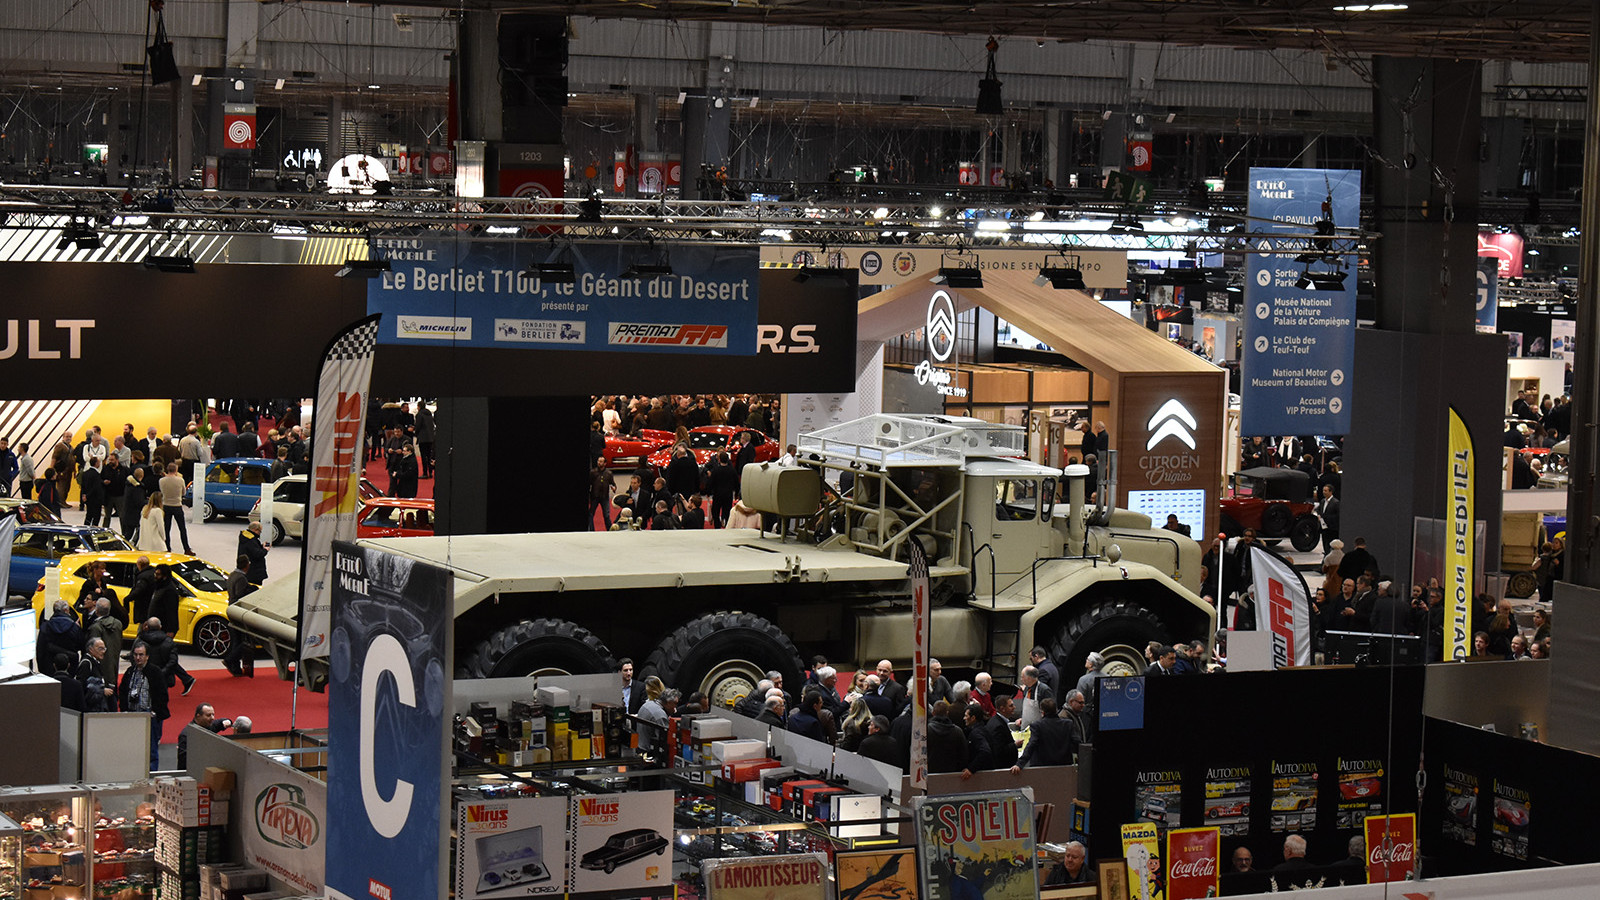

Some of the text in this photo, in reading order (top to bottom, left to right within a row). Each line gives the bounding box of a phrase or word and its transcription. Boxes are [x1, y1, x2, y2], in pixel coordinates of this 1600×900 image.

[520, 152, 542, 161] 1203
[1256, 180, 1287, 190] RETRO
[1275, 269, 1298, 278] Sortie
[383, 270, 406, 290] Le
[413, 267, 486, 293] Berliet
[581, 272, 642, 299] Géant
[648, 277, 673, 299] du
[680, 279, 750, 301] Desert
[1275, 279, 1300, 287] Parki
[1274, 297, 1332, 306] Musée National
[542, 301, 589, 313] présenté par
[1273, 308, 1321, 316] de la Voiture
[521, 321, 557, 329] FONDATION
[1273, 317, 1350, 327] Palais de Compiègne
[419, 324, 468, 333] MICHELIN
[615, 324, 681, 337] PREMAT
[521, 330, 557, 340] BERLIET
[1273, 336, 1316, 345] Le Club des
[1272, 345, 1310, 354] Teuf-Teuf
[1272, 368, 1328, 377] National Motor
[1251, 378, 1328, 387] Museum of Beaulieu
[1299, 397, 1327, 406] Accueil
[1286, 406, 1327, 415] VIP Presse
[314, 391, 362, 518] Virus
[1139, 452, 1200, 469] CITROËN
[1145, 465, 1192, 486] Origins
[336, 551, 363, 576] RETRO
[340, 571, 371, 597] MOBILE
[360, 633, 417, 839] C
[1136, 771, 1182, 783] AUTODIVA
[1206, 767, 1251, 779] AUTODIVA
[580, 798, 620, 816] Virus
[468, 804, 509, 823] Virus
[938, 799, 1031, 845] SOLEIL
[1123, 830, 1156, 839] MAZDA
[922, 805, 941, 900] CYCLE
[1183, 845, 1204, 853] BUVEZ
[714, 861, 820, 890] L'AMORTISSEUR
[369, 880, 392, 900] MOTUL
[527, 885, 560, 895] NOREV
